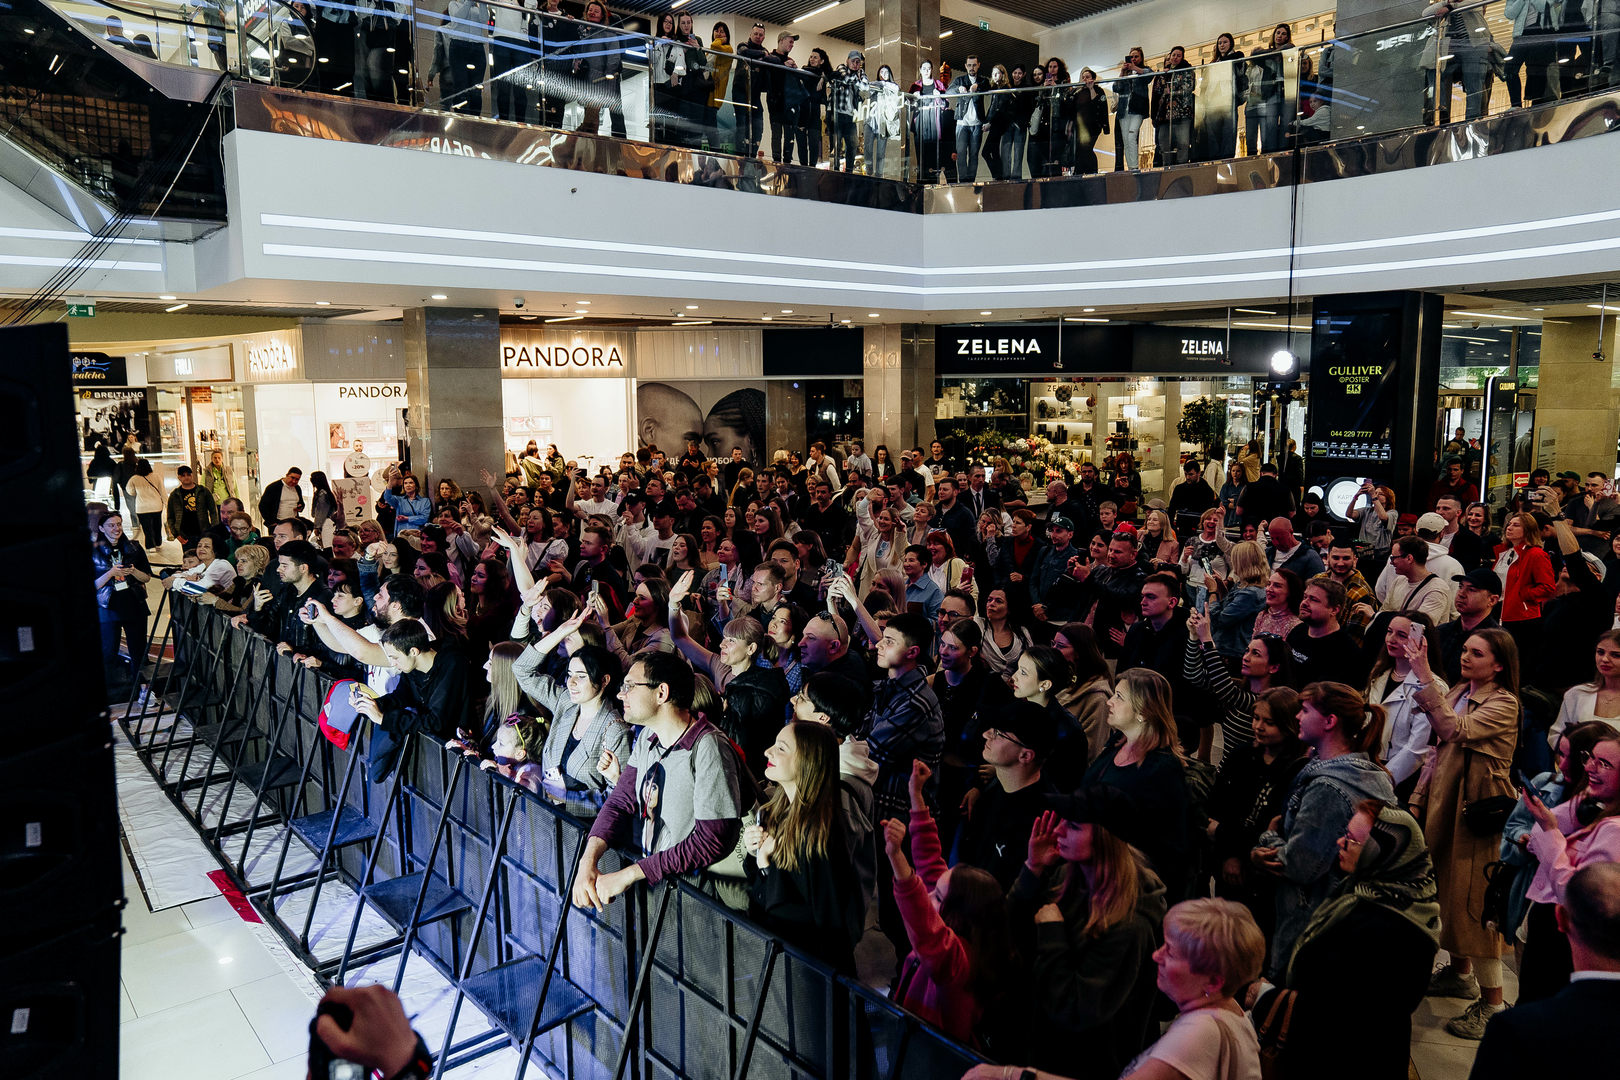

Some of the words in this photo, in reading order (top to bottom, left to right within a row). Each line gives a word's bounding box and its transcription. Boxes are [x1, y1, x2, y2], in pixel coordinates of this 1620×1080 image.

[957, 338, 1041, 354] ZELENA
[1181, 339, 1224, 354] ZELENA
[248, 345, 289, 370] PANDORA
[503, 346, 623, 367] PANDORA
[1328, 365, 1383, 376] GULLIVER
[94, 391, 144, 399] BREITLING
[1357, 430, 1373, 438] 7777
[354, 506, 364, 518] 2
